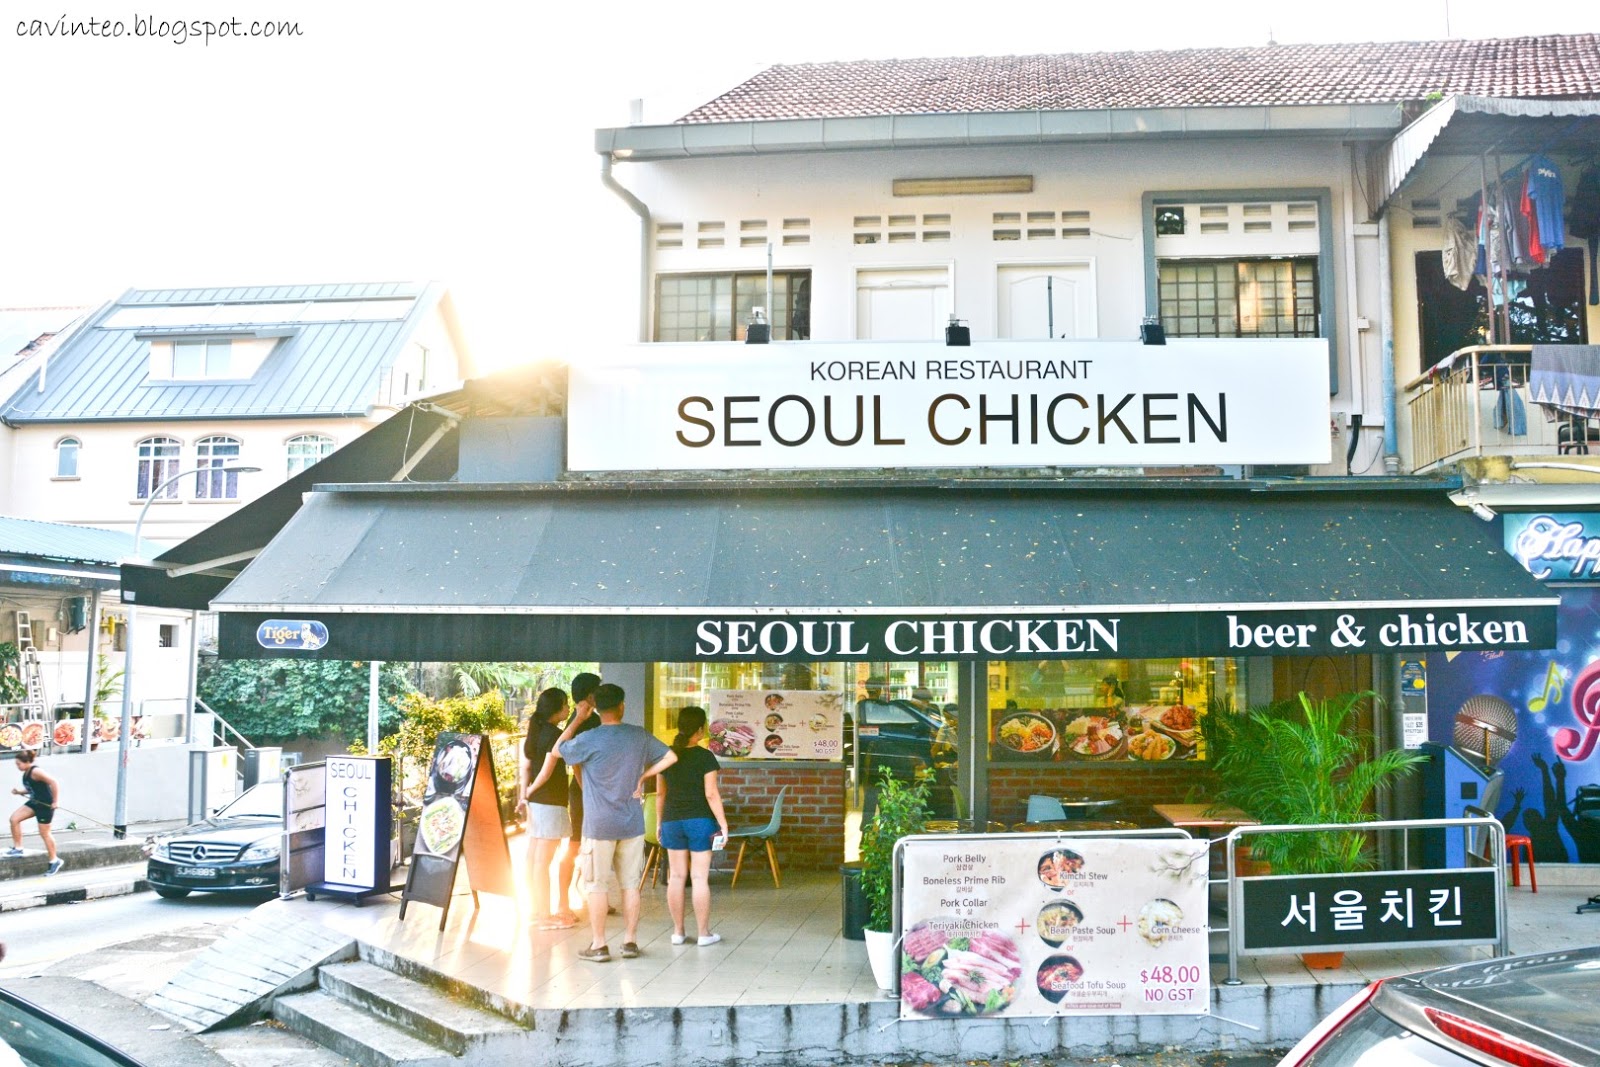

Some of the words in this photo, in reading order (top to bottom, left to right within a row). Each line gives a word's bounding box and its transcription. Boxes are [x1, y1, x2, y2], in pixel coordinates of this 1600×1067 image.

[811, 360, 915, 381] KOREAN
[926, 360, 1093, 380] RESTAURANT
[676, 394, 906, 448] SEOUL
[927, 392, 1228, 446] CHICKEN
[263, 626, 300, 645] Tiger
[695, 620, 870, 656] SEOUL
[884, 618, 1121, 656] CHICKEN
[1226, 615, 1317, 649] beer
[1330, 614, 1366, 648] &
[1379, 612, 1530, 647] chicken
[330, 762, 371, 780] SEOUL
[343, 786, 357, 879] CHICKEN
[943, 854, 962, 863] Pork
[965, 854, 986, 863] Belly
[923, 876, 961, 885] Boneless
[964, 876, 989, 885] Prime
[991, 876, 1006, 884] Rib
[1059, 872, 1086, 880] Kimchi
[1088, 872, 1108, 880] Stew
[940, 899, 960, 907] Pork
[962, 898, 988, 907] Collar
[929, 921, 963, 930] Teriyaki
[964, 920, 999, 929] Chicken
[1050, 926, 1070, 934] Bean
[1072, 926, 1094, 934] Paste
[1096, 926, 1116, 936] Soup
[1151, 926, 1170, 934] Corn
[1171, 926, 1200, 934] Cheese
[1140, 965, 1200, 986] $48,00
[1052, 981, 1084, 989] Seafood
[1087, 981, 1104, 989] Tofu
[1106, 981, 1126, 990] Soup
[1145, 988, 1164, 1001] NO
[1168, 988, 1195, 1001] GST
